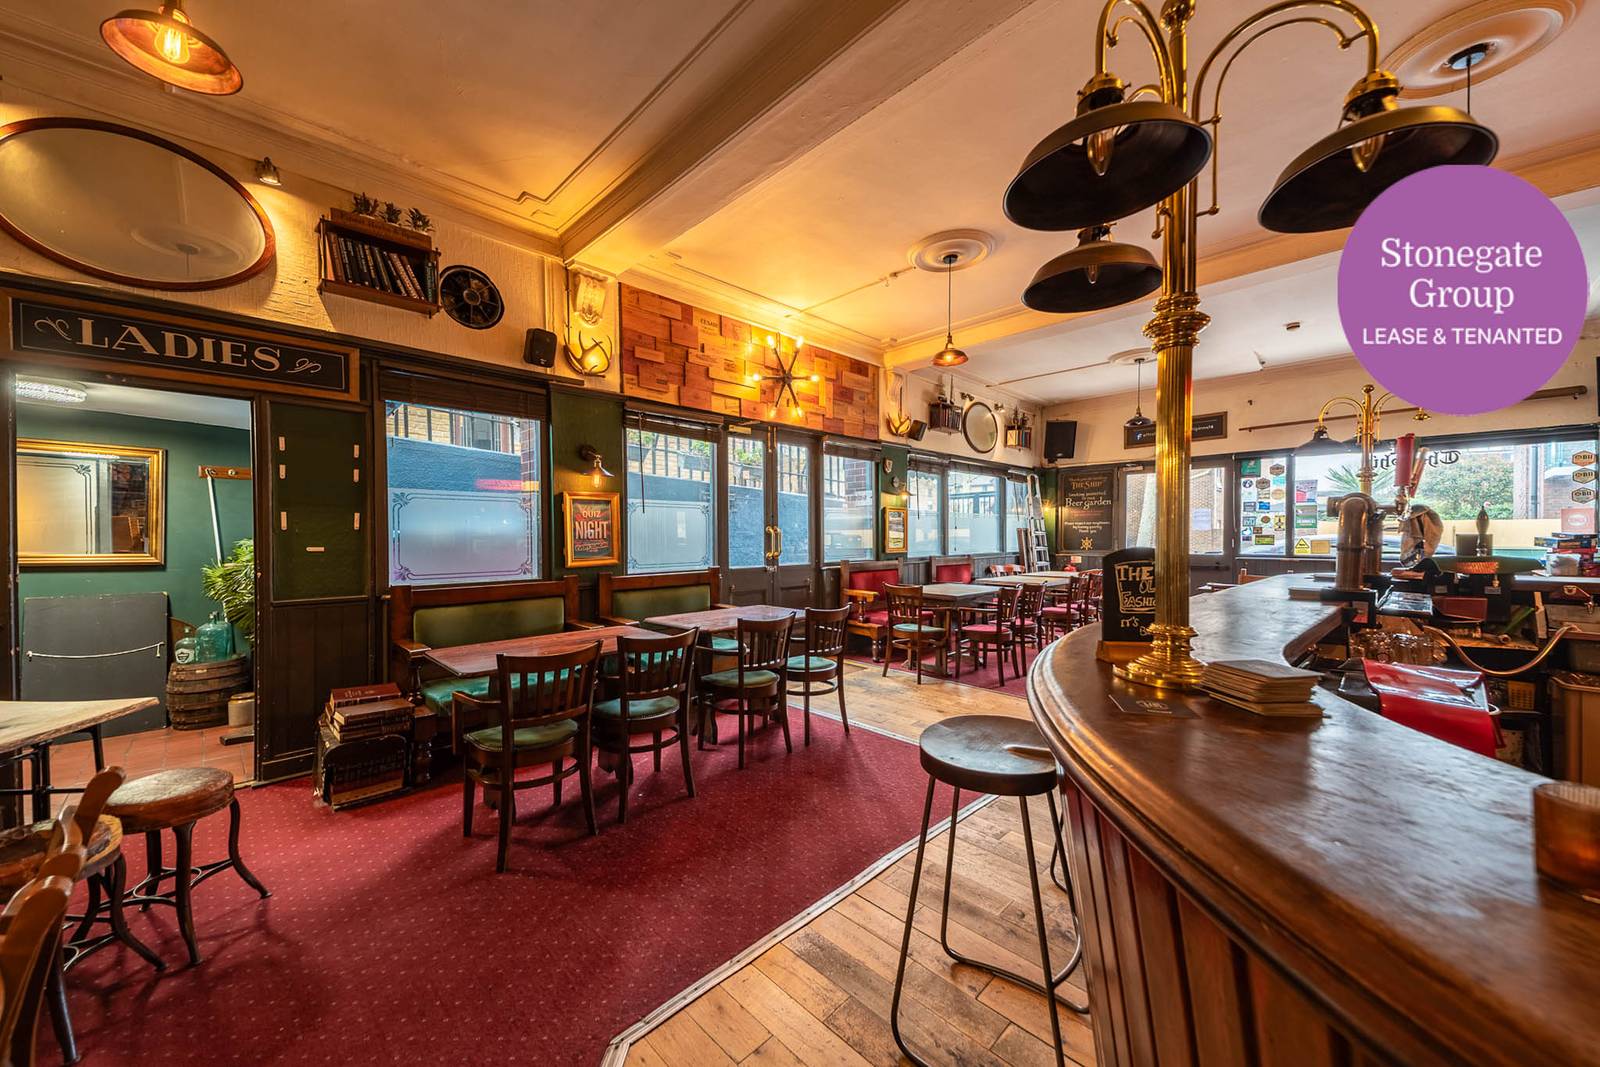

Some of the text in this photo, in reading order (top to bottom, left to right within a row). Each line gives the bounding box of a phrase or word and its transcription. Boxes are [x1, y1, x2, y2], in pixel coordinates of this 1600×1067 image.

[76, 317, 281, 372] LADIES
[1065, 497, 1083, 507] Beer
[1084, 497, 1112, 510] garden
[582, 510, 601, 518] QUIZ
[575, 521, 608, 540] NIGHT
[1117, 565, 1154, 581] THE
[1139, 579, 1156, 594] OL
[1120, 616, 1140, 628] IT'S
